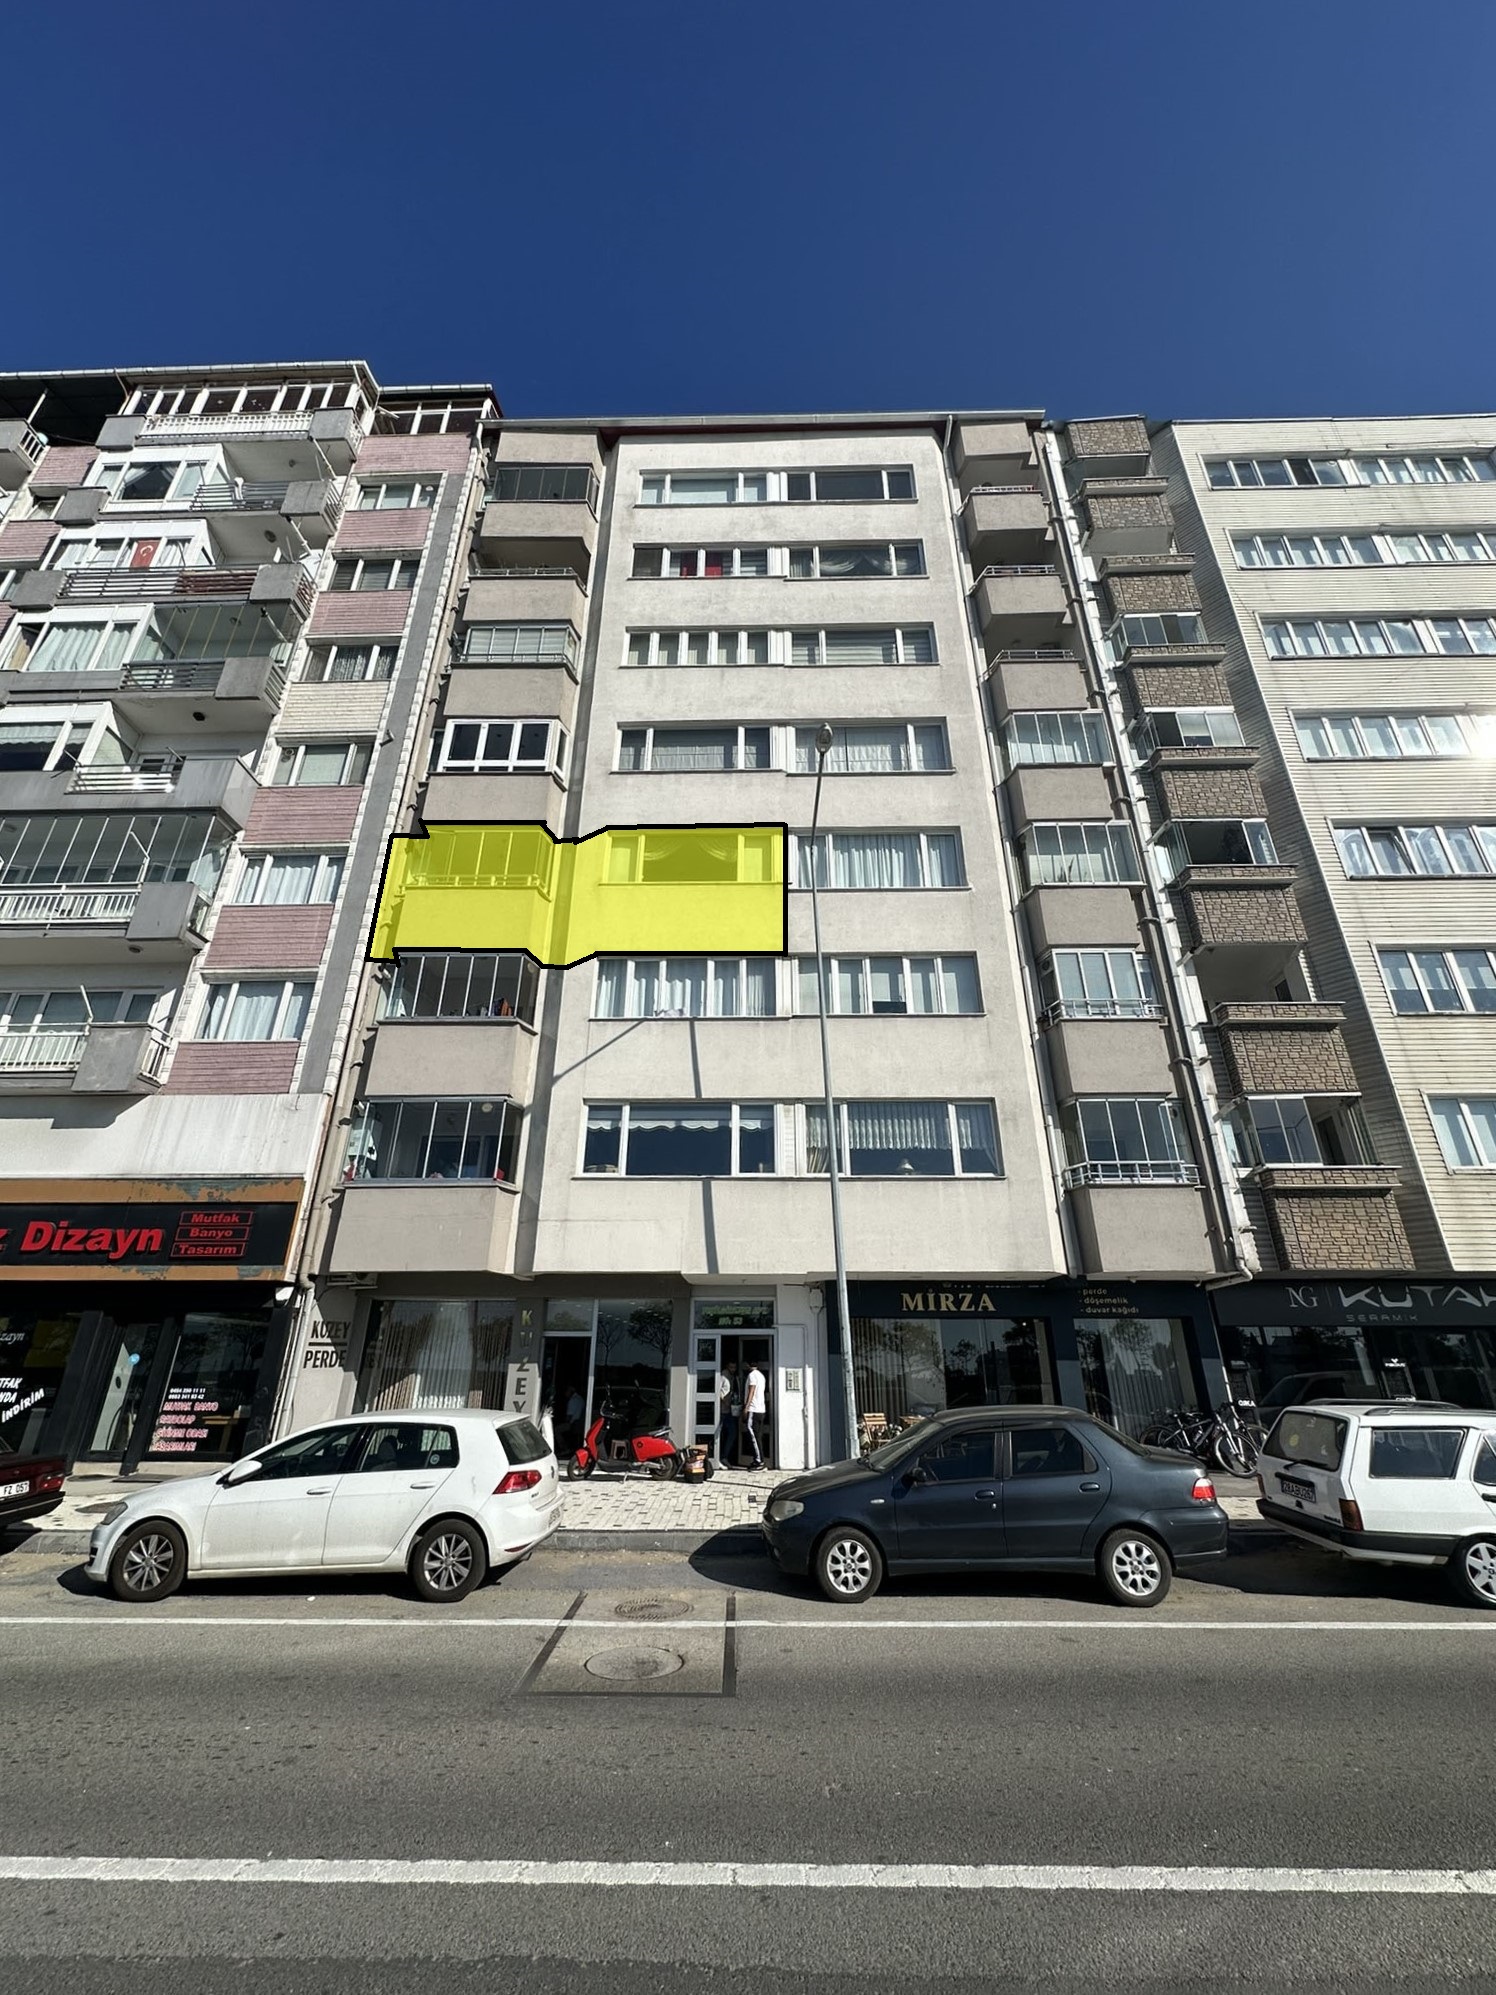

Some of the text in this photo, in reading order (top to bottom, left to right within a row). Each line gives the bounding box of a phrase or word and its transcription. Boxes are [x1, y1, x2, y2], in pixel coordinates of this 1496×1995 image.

[191, 1213, 240, 1223] Mutfak
[20, 1221, 164, 1259] Dizayn
[189, 1228, 233, 1240] Banyo
[179, 1244, 237, 1254] Tasarım
[1083, 1288, 1107, 1296] perde
[1286, 1286, 1318, 1308] NG
[901, 1288, 997, 1312] MİRZA
[311, 1320, 351, 1339] KUZEY
[303, 1350, 347, 1368] PERDE
[0, 1377, 23, 1389] TFAK
